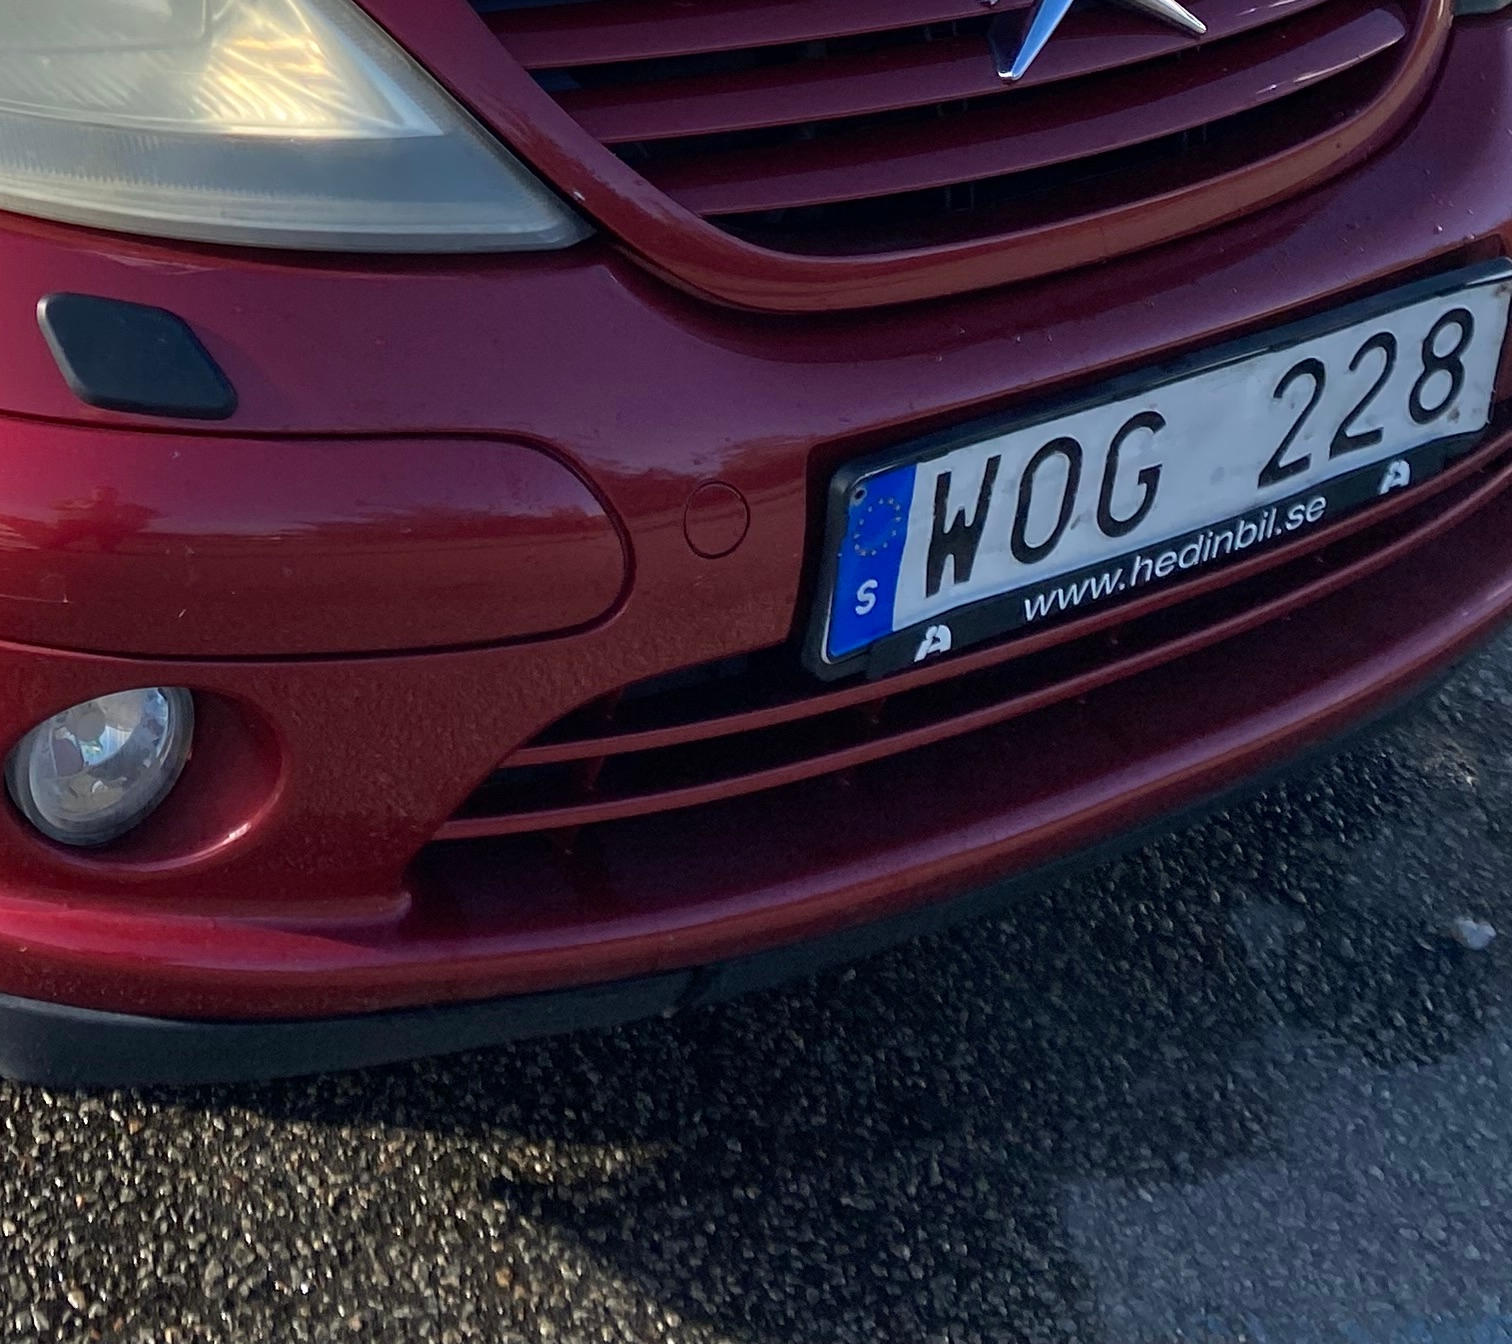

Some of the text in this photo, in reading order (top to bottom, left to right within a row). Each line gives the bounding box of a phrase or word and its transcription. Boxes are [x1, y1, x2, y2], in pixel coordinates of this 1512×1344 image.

[925, 308, 1475, 598] WOG 228
[855, 578, 878, 616] S
[1024, 494, 1327, 621] www.hedinbil.se
